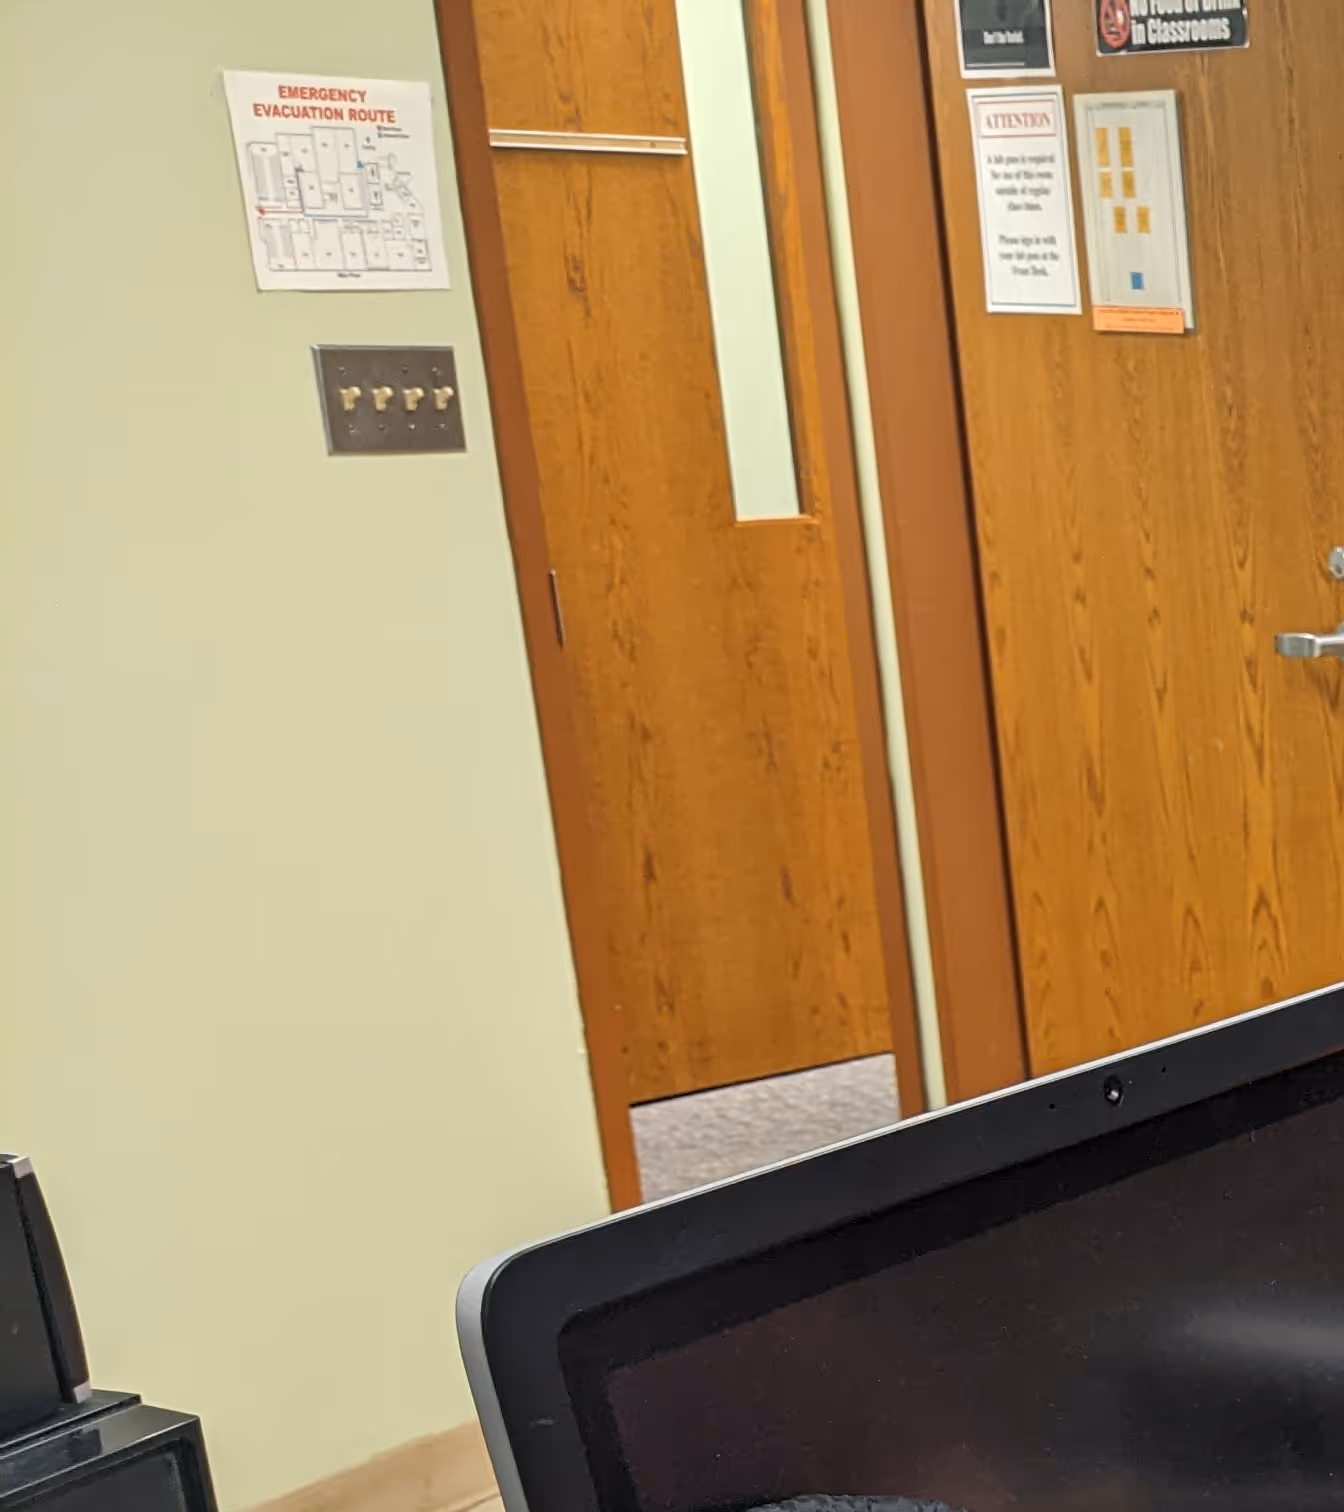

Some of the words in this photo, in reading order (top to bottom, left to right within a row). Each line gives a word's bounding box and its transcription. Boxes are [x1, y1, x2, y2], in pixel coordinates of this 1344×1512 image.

[1130, 19, 1146, 45] in
[1147, 17, 1231, 44] Classrooms
[278, 84, 368, 103] EMERGENCY
[253, 103, 344, 121] EVACUATION
[348, 108, 396, 124] ROUTE
[985, 112, 1051, 129] ATTENTION
